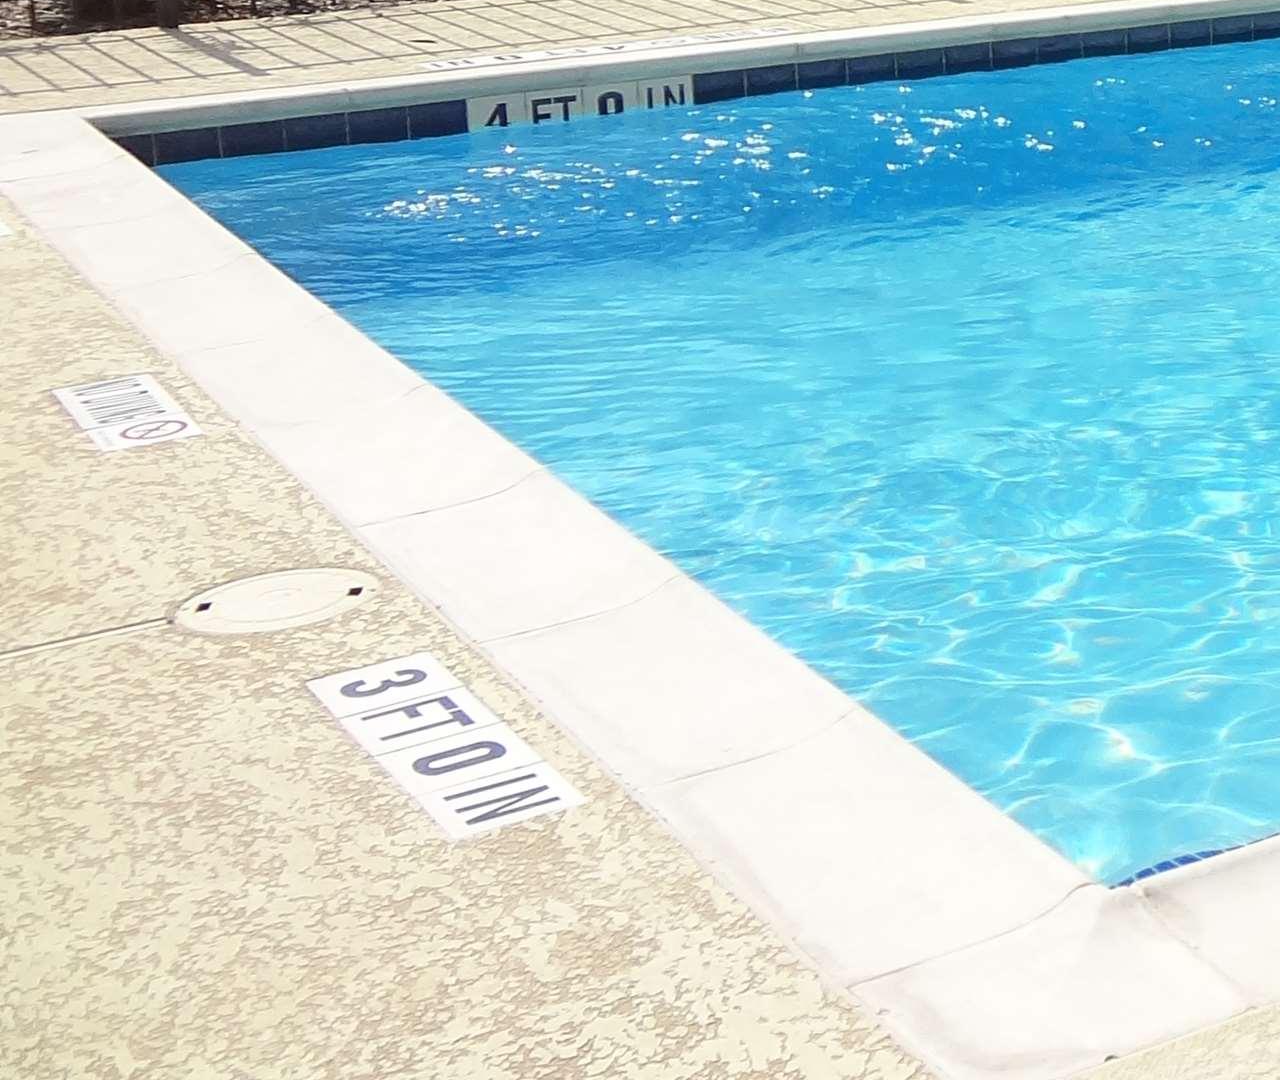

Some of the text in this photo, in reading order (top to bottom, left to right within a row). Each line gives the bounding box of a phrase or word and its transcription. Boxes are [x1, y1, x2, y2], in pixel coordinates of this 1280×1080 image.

[484, 102, 511, 128] 4
[532, 95, 577, 125] FT
[646, 83, 685, 109] IN
[339, 669, 427, 698] 3
[361, 695, 476, 741] FT
[442, 772, 561, 825] IN
